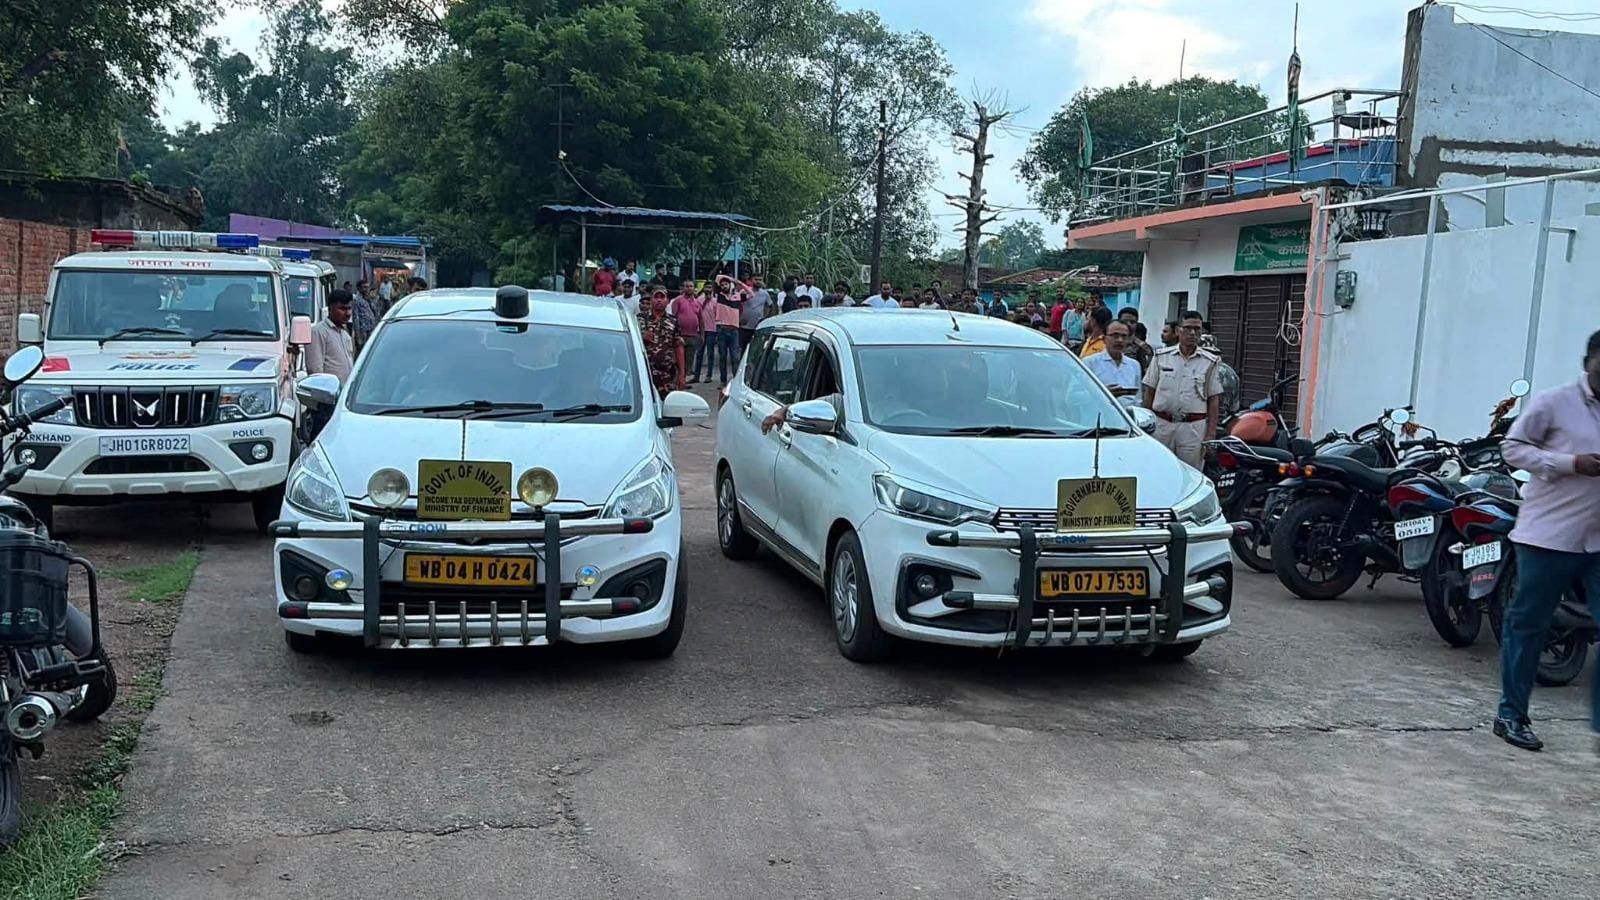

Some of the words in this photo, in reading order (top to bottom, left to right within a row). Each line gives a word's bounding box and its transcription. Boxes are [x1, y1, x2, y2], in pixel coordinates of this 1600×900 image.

[106, 362, 200, 371] POLICE
[9, 433, 72, 443] JRKHAND
[232, 428, 265, 438] POLICE
[109, 438, 188, 452] JH01GR8022
[424, 467, 456, 495] GOVT.
[457, 464, 473, 478] OF
[475, 467, 502, 495] INDIA
[424, 496, 449, 504] INCOME
[464, 497, 504, 506] DEPARTMENT
[1063, 481, 1106, 517] GOVERNMENT
[1105, 482, 1117, 495] OF
[1113, 489, 1131, 514] INDIA
[424, 504, 460, 512] MINISTRY
[461, 505, 470, 513] OF
[472, 505, 505, 514] FINANCE
[1062, 517, 1093, 527] MINISTRY
[1094, 516, 1103, 526] OF
[1103, 515, 1131, 525] FINANCE
[409, 523, 447, 533] CROW
[1055, 535, 1089, 544] CROW
